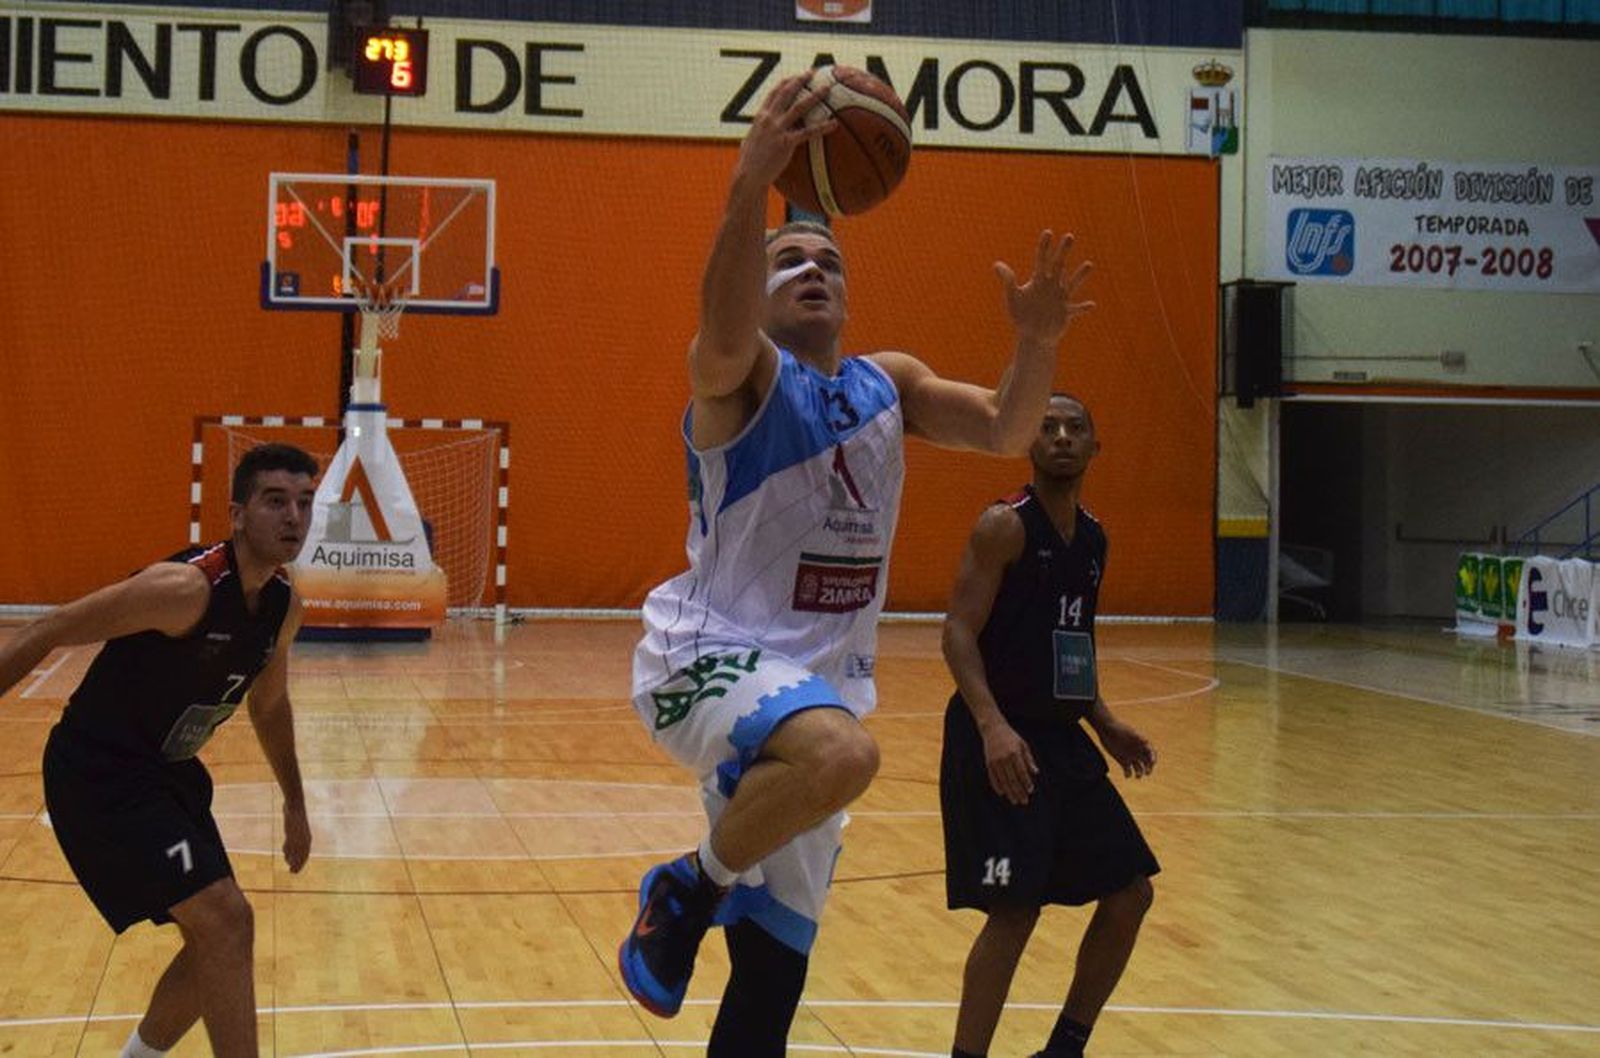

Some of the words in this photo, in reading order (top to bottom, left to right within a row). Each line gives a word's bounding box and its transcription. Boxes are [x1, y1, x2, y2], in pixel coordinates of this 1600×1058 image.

[0, 16, 318, 104] IENTO
[454, 38, 585, 118] DE
[1272, 165, 1344, 199] MEJOR
[1353, 162, 1443, 201] AFICIÓN
[1454, 166, 1554, 204] DIVISIÓN
[1565, 175, 1594, 206] DE
[1415, 214, 1530, 236] TEMPORADA
[1390, 244, 1554, 279] 2007-2008
[820, 386, 861, 433] 13
[311, 545, 415, 571] Aquimisa
[1058, 595, 1082, 626] 14
[166, 839, 193, 872] 7
[982, 856, 1011, 886] 14
